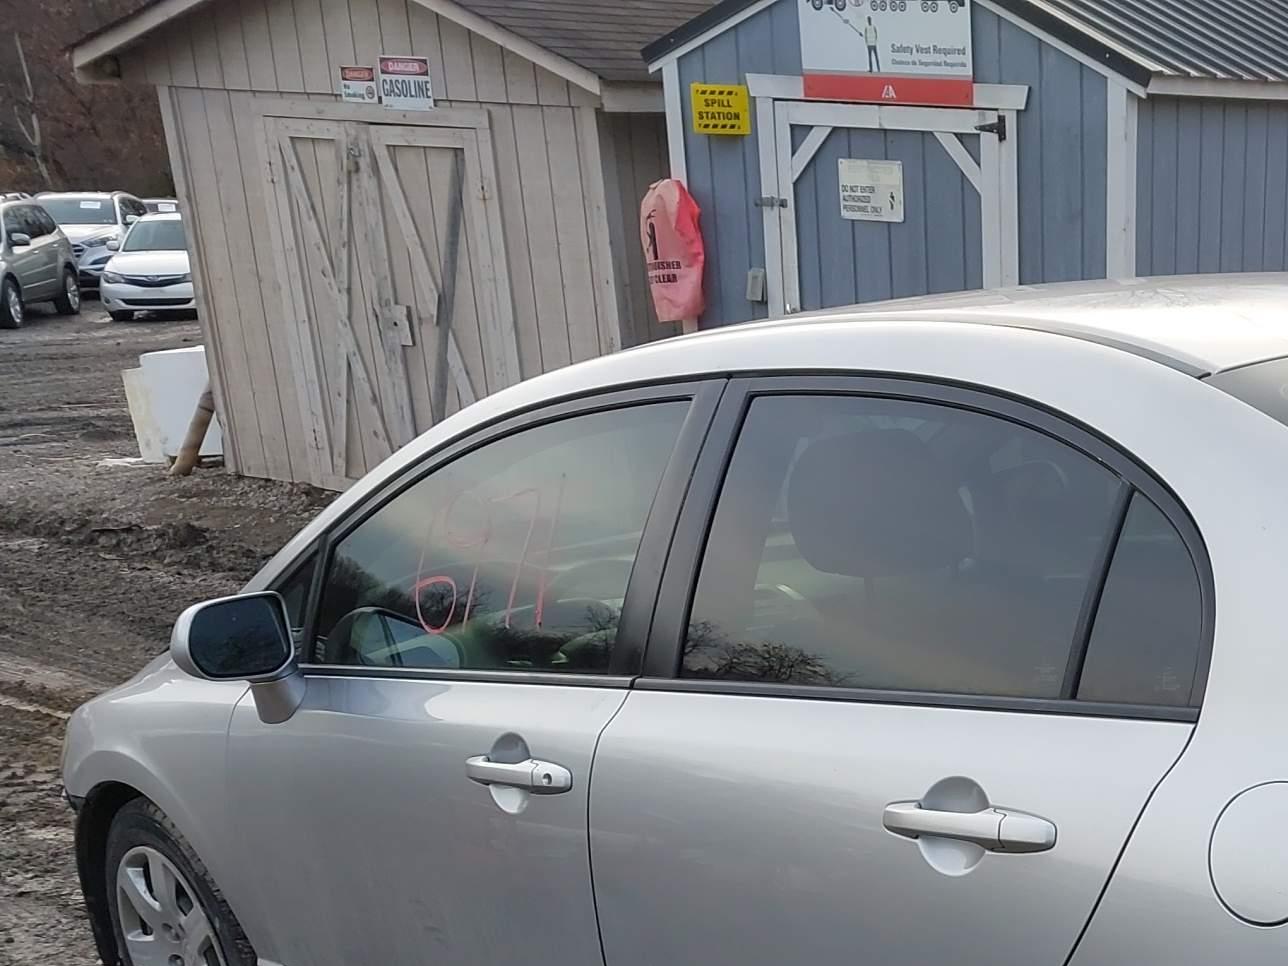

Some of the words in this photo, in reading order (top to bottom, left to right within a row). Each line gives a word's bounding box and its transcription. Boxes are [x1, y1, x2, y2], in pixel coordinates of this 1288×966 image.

[890, 43, 913, 55] Safety
[915, 44, 931, 54] Vest
[933, 44, 966, 56] Required
[388, 61, 420, 73] DANGER
[382, 79, 431, 98] GASOLINE
[704, 98, 733, 108] SPILL
[698, 111, 740, 121] STATION
[841, 184, 849, 192] DO
[850, 185, 859, 193] NOT
[860, 185, 875, 194] ENTER
[870, 206, 882, 214] ONLY
